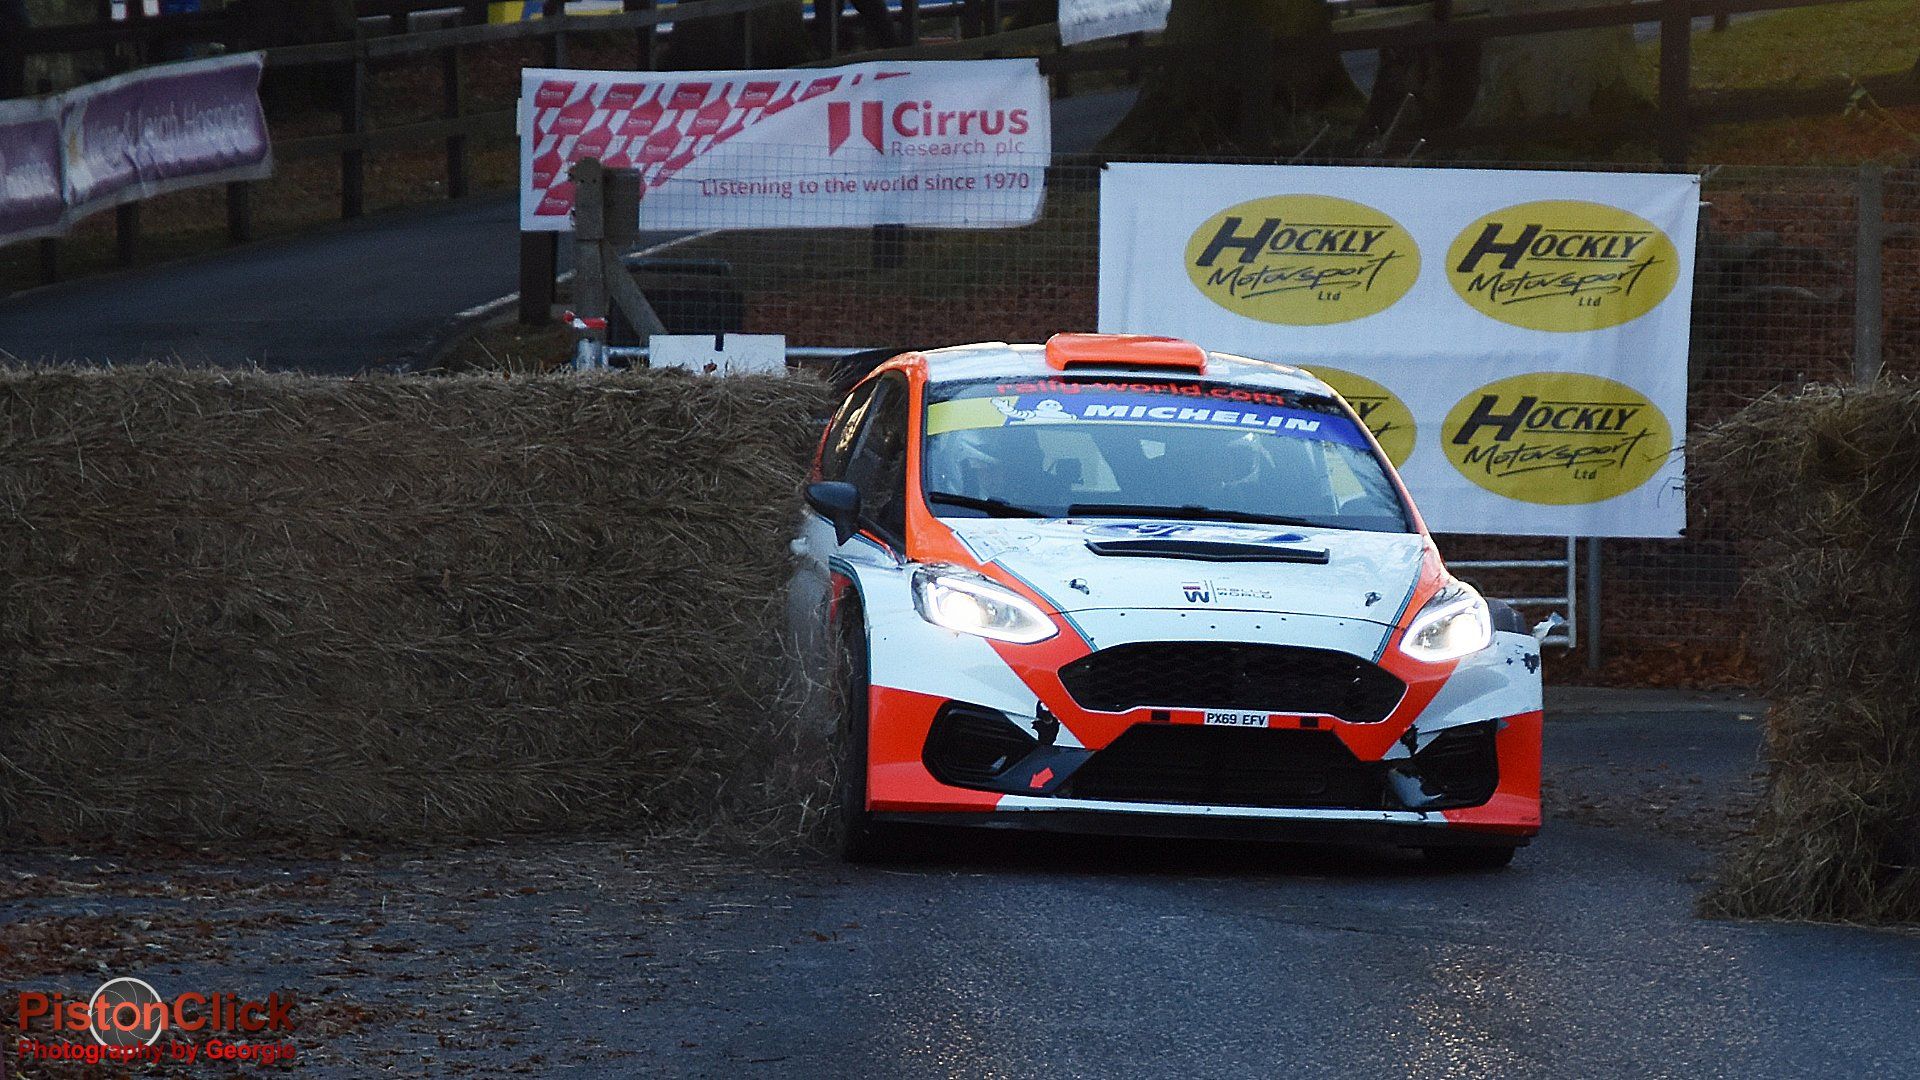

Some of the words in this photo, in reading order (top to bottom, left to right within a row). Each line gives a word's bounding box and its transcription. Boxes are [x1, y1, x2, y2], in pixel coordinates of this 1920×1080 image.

[892, 100, 1030, 138] Cirrus
[891, 139, 985, 157] Research
[995, 138, 1025, 158] plc
[702, 177, 793, 199] Listening
[799, 177, 819, 193] to
[824, 175, 856, 193] the
[861, 173, 918, 193] world
[924, 172, 976, 191] since
[983, 172, 1029, 189] 1970
[1196, 216, 1386, 267] HOCKLY
[1456, 223, 1647, 273] HOCKLY
[1207, 250, 1406, 296] Motorsport
[1467, 256, 1665, 302] Motorsport
[1318, 290, 1342, 301] Ltd
[1578, 296, 1602, 307] Ltd
[996, 376, 1285, 406] rally-world.com
[1083, 403, 1320, 432] MICHELIN
[1452, 394, 1640, 445] HOCKLY
[1463, 428, 1656, 474] Motorsport
[1574, 468, 1597, 480] Ltd
[1206, 712, 1237, 725] PX69
[1242, 714, 1266, 726] EFV
